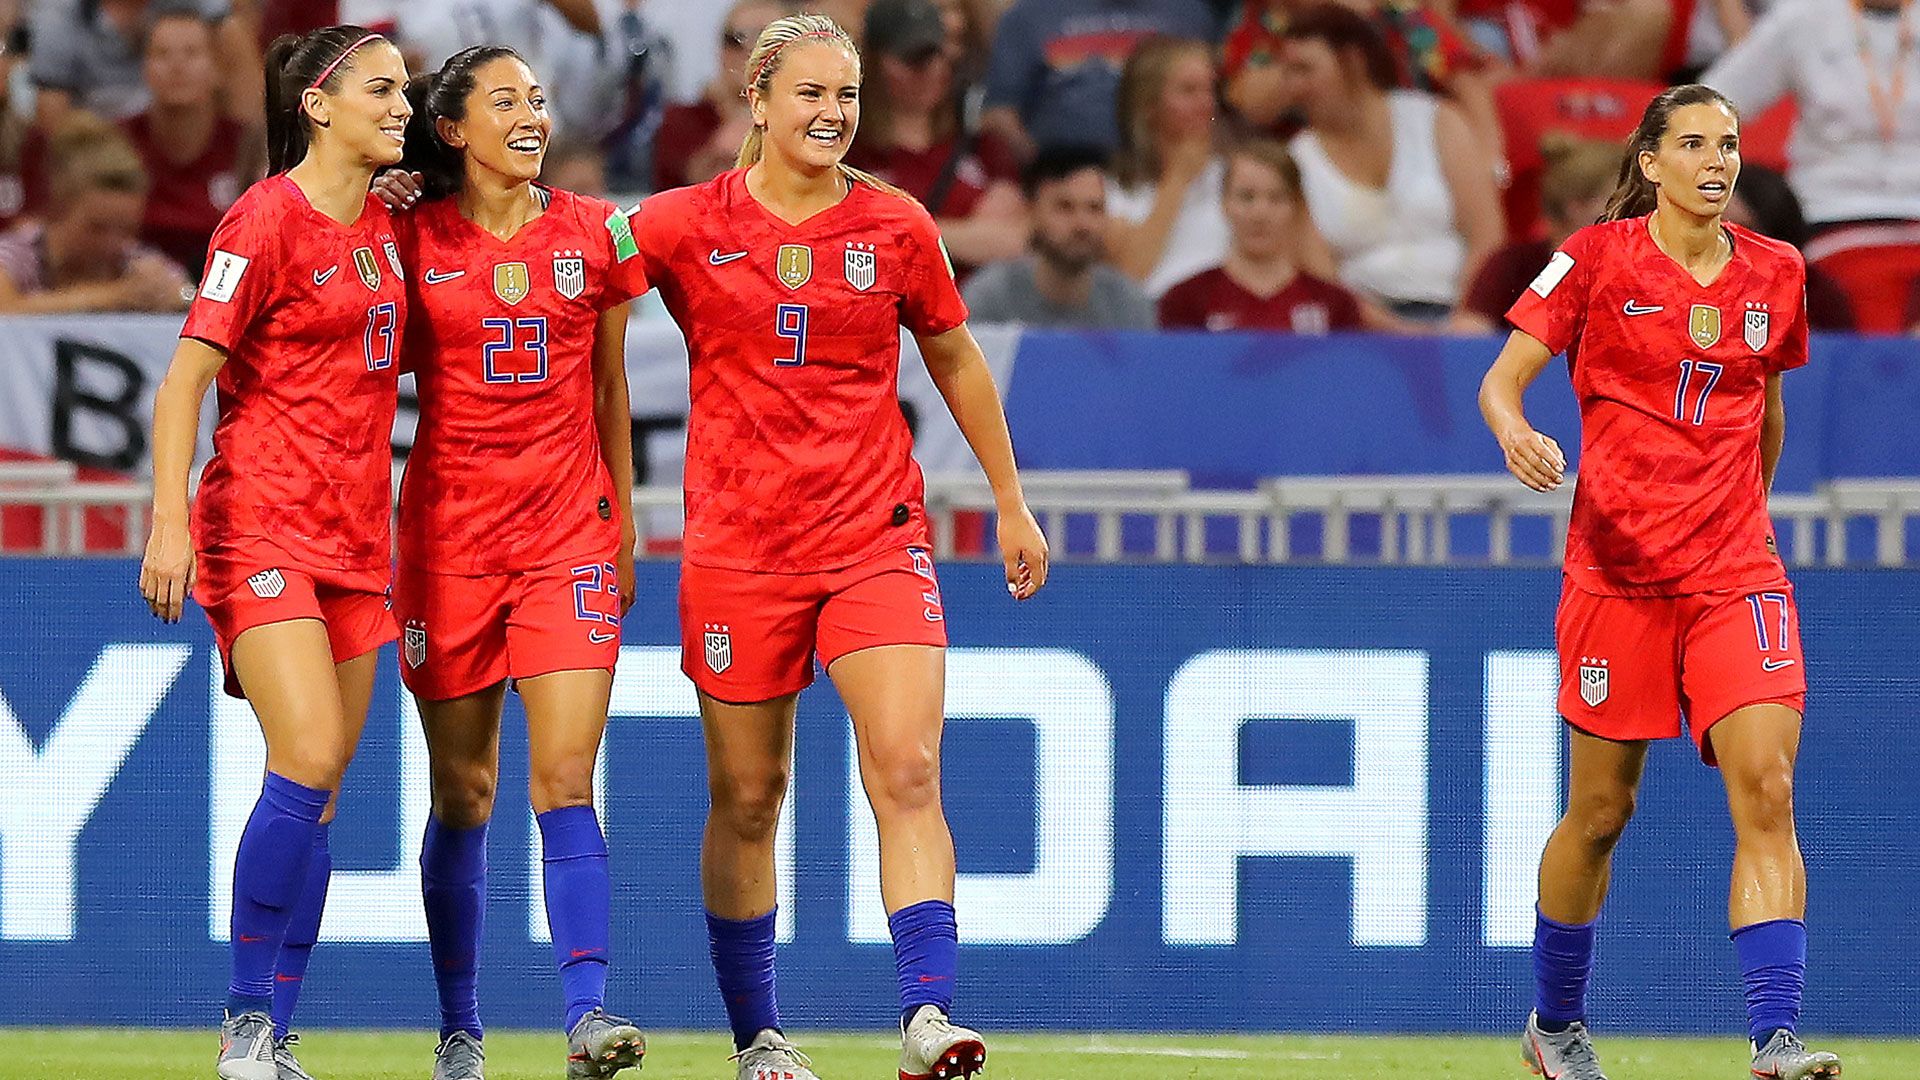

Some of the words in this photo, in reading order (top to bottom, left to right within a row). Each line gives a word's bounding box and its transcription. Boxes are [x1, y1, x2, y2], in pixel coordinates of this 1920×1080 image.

[847, 252, 873, 268] USA
[556, 261, 580, 277] USA
[1747, 313, 1766, 329] USA
[364, 302, 397, 371] 13
[774, 303, 808, 367] 9
[482, 316, 548, 384] 23
[1674, 359, 1724, 426] 17
[1745, 592, 1789, 652] 17
[406, 629, 424, 646] USA
[706, 635, 728, 651] USA
[1582, 668, 1606, 684] USA
